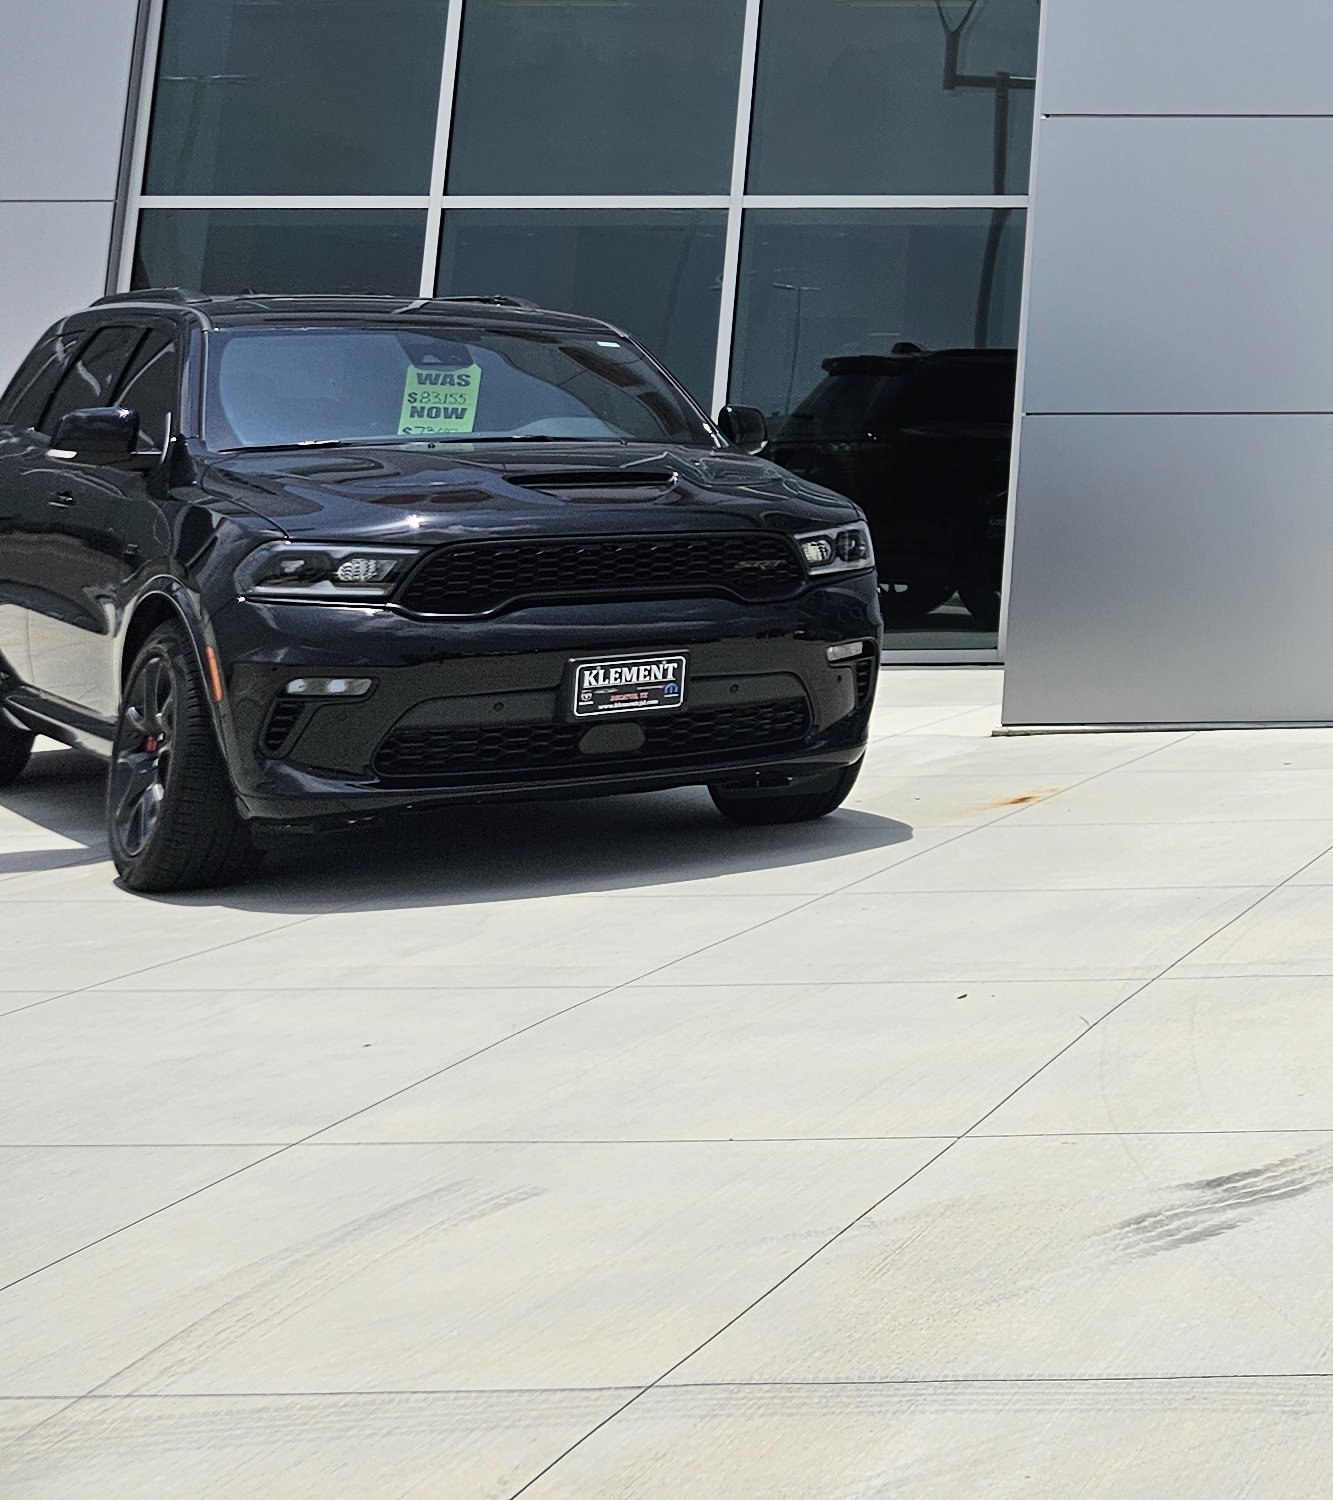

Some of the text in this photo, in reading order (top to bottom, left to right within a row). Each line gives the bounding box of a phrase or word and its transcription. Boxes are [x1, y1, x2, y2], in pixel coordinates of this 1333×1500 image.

[416, 372, 471, 387] WAS
[409, 405, 468, 420] NOW
[583, 662, 678, 687] KLEMENT
